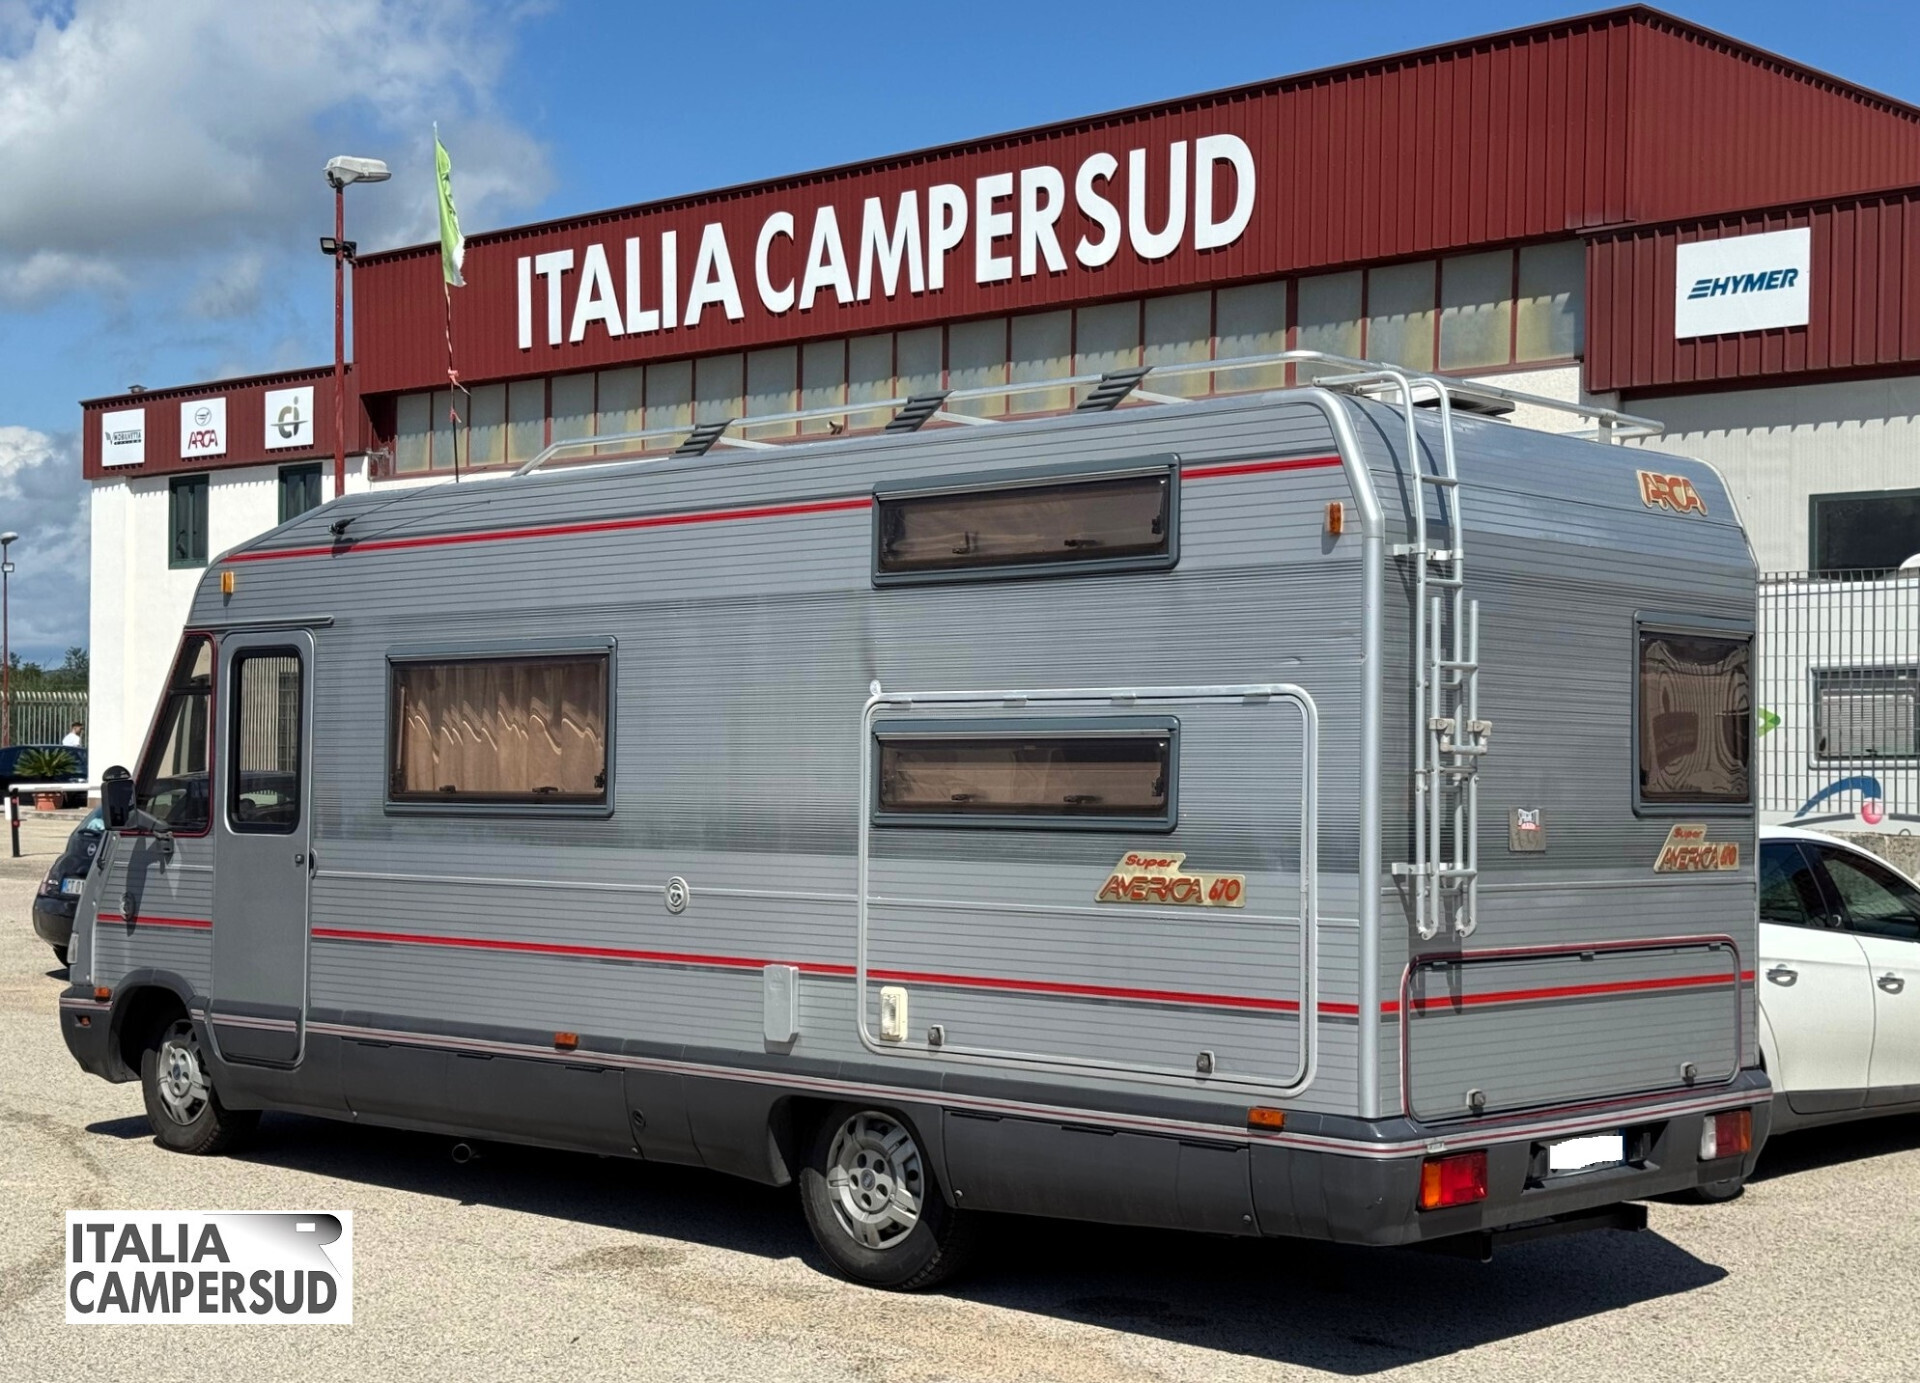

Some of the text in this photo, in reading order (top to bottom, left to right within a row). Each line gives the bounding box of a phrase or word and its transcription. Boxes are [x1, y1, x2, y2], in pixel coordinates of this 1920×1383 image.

[517, 133, 1256, 349] ITALIA CAMPERSUD
[1709, 268, 1799, 297] HYMER
[187, 429, 218, 450] ARCA
[1640, 472, 1707, 516] ARCA
[1673, 827, 1703, 840] Super
[1125, 854, 1177, 869] Super
[1209, 878, 1241, 902] 670
